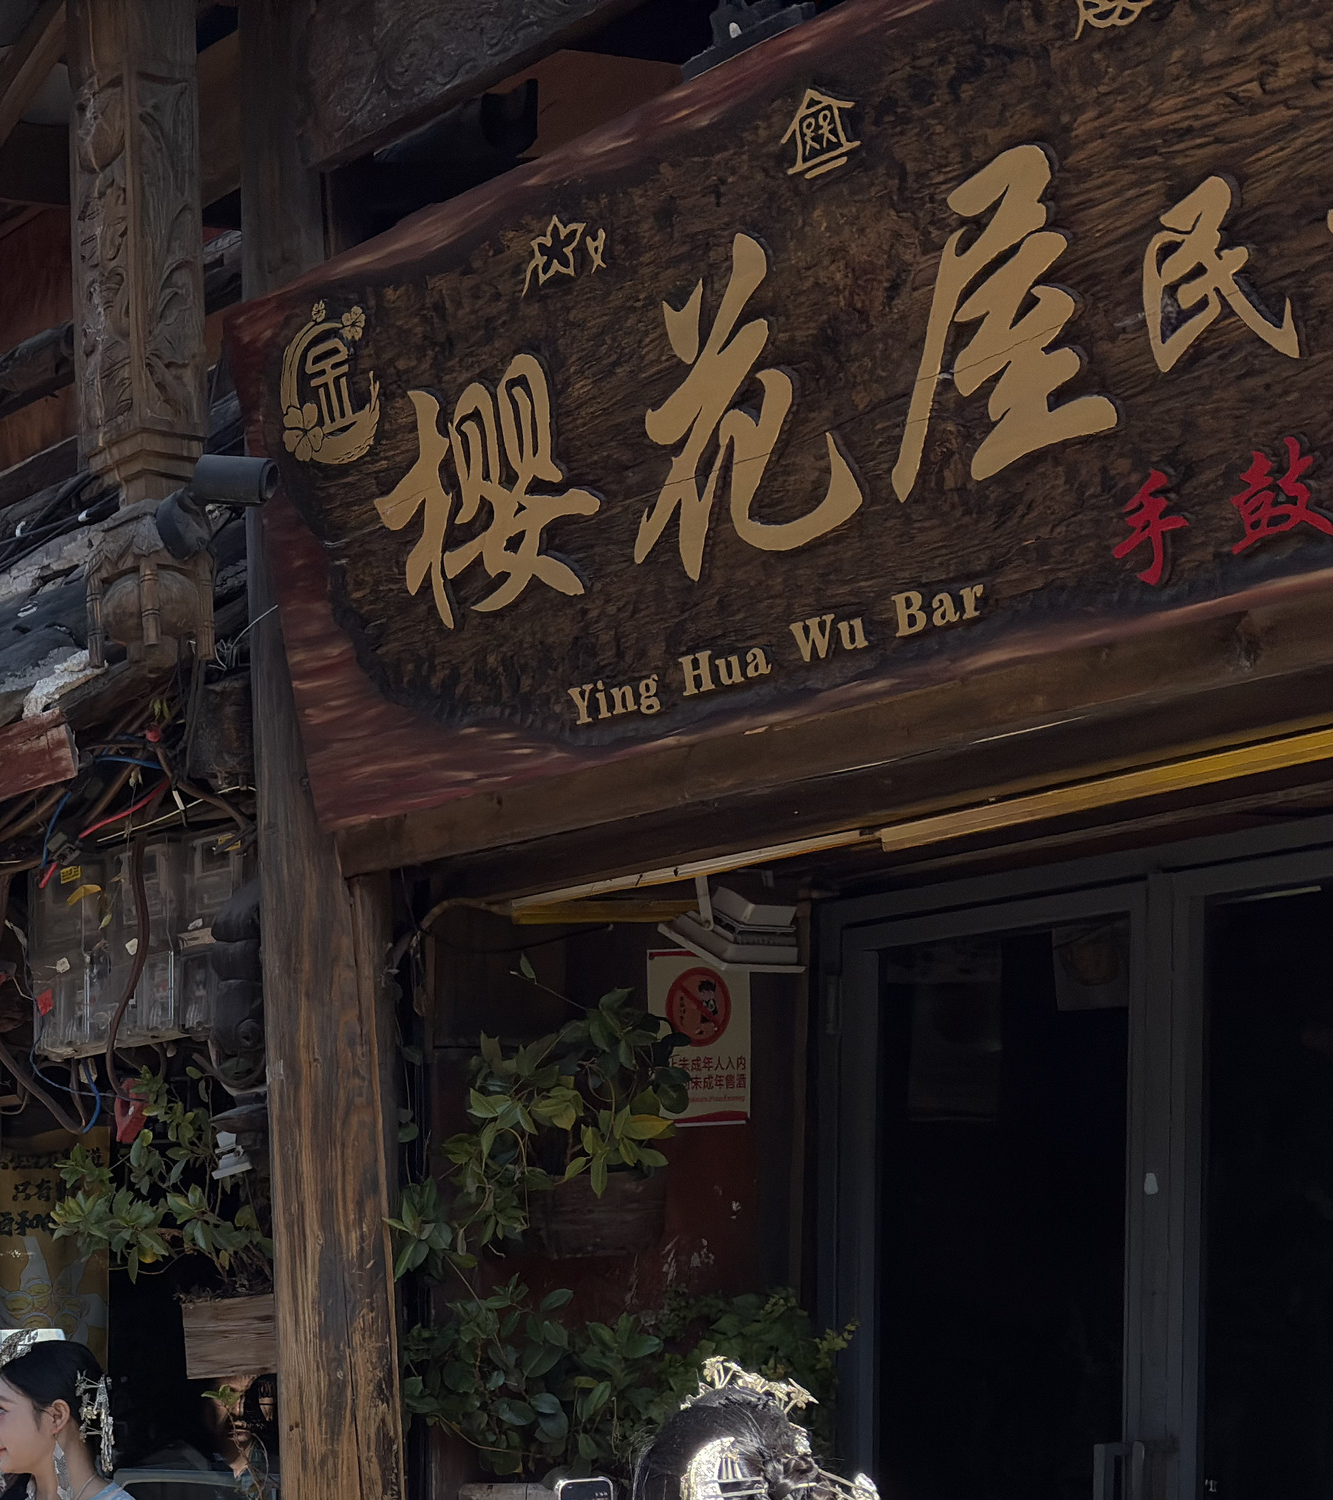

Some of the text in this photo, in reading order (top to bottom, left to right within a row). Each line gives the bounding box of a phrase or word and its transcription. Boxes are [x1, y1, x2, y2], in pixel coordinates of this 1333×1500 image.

[567, 583, 984, 725] Ying Hua Wu Bar
